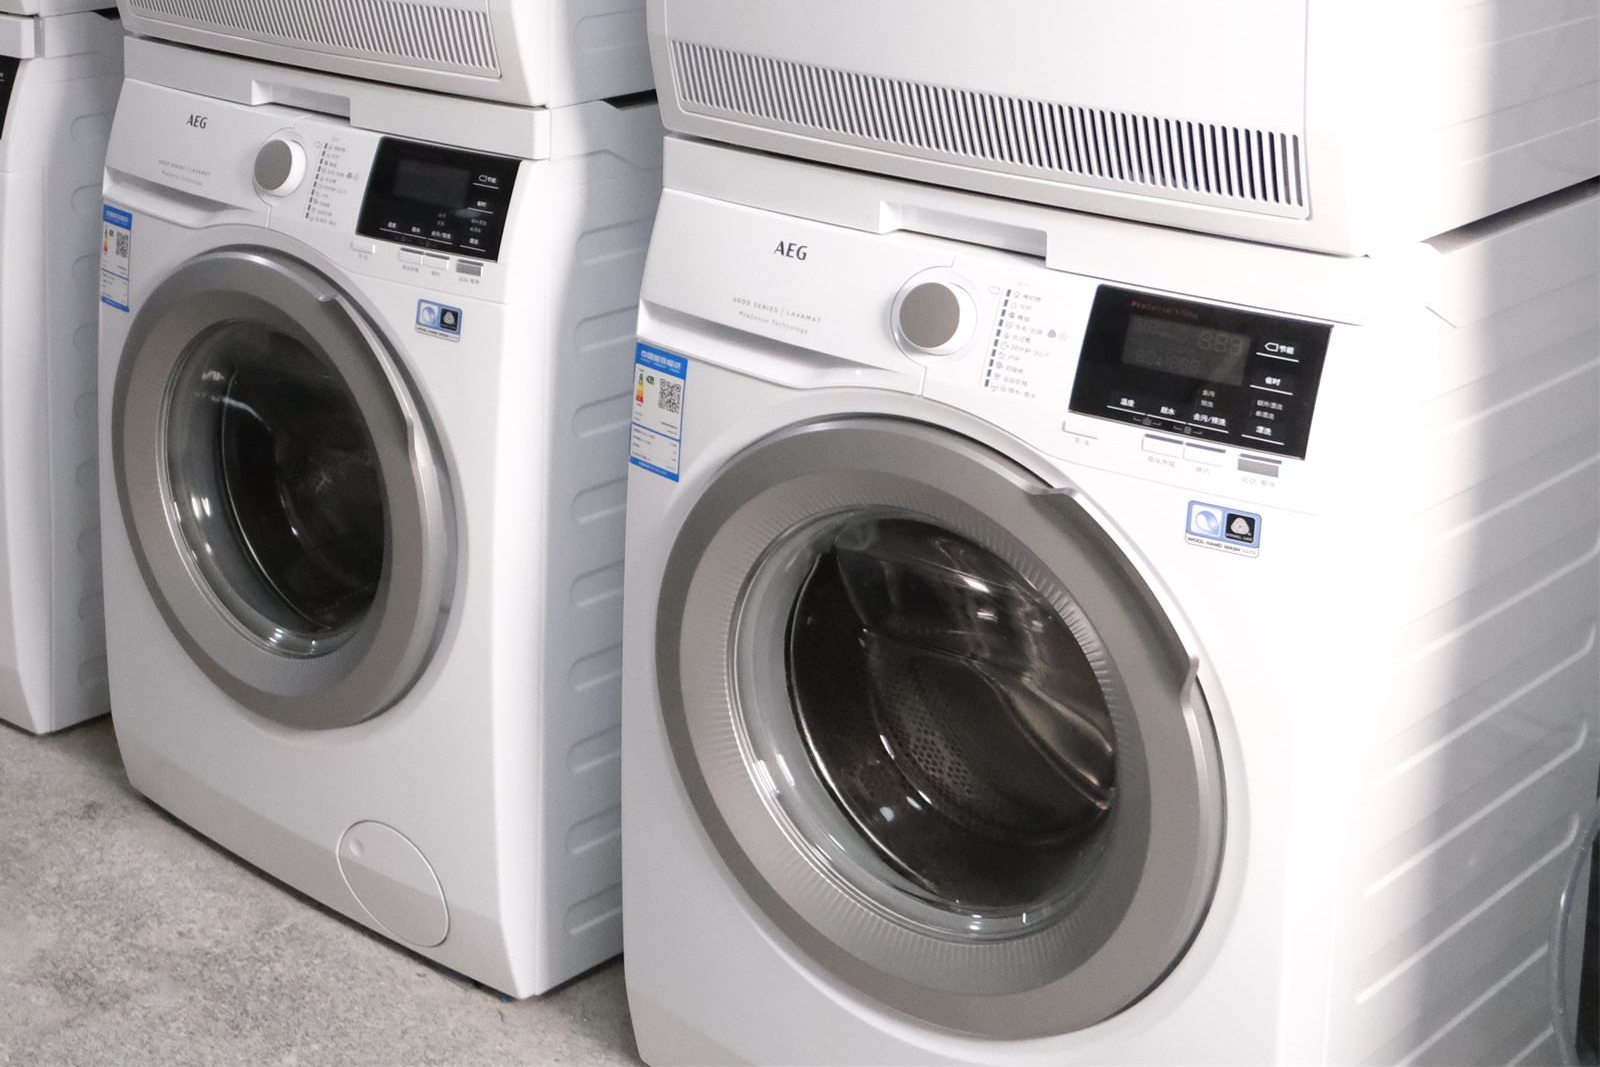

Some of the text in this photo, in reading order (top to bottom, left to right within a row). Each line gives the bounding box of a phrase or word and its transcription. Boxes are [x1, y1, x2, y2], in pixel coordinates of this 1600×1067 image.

[186, 114, 208, 130] AEG
[773, 240, 808, 261] AEG
[732, 297, 821, 323] 6000 SERIES LAVAMAT
[739, 311, 809, 335] ProSense Technology
[1120, 397, 1135, 408] 温度
[1193, 413, 1227, 428] 去污/预洗
[1187, 536, 1205, 545] WOOL
[1206, 540, 1223, 549] HAND
[1224, 544, 1241, 552] WASH
